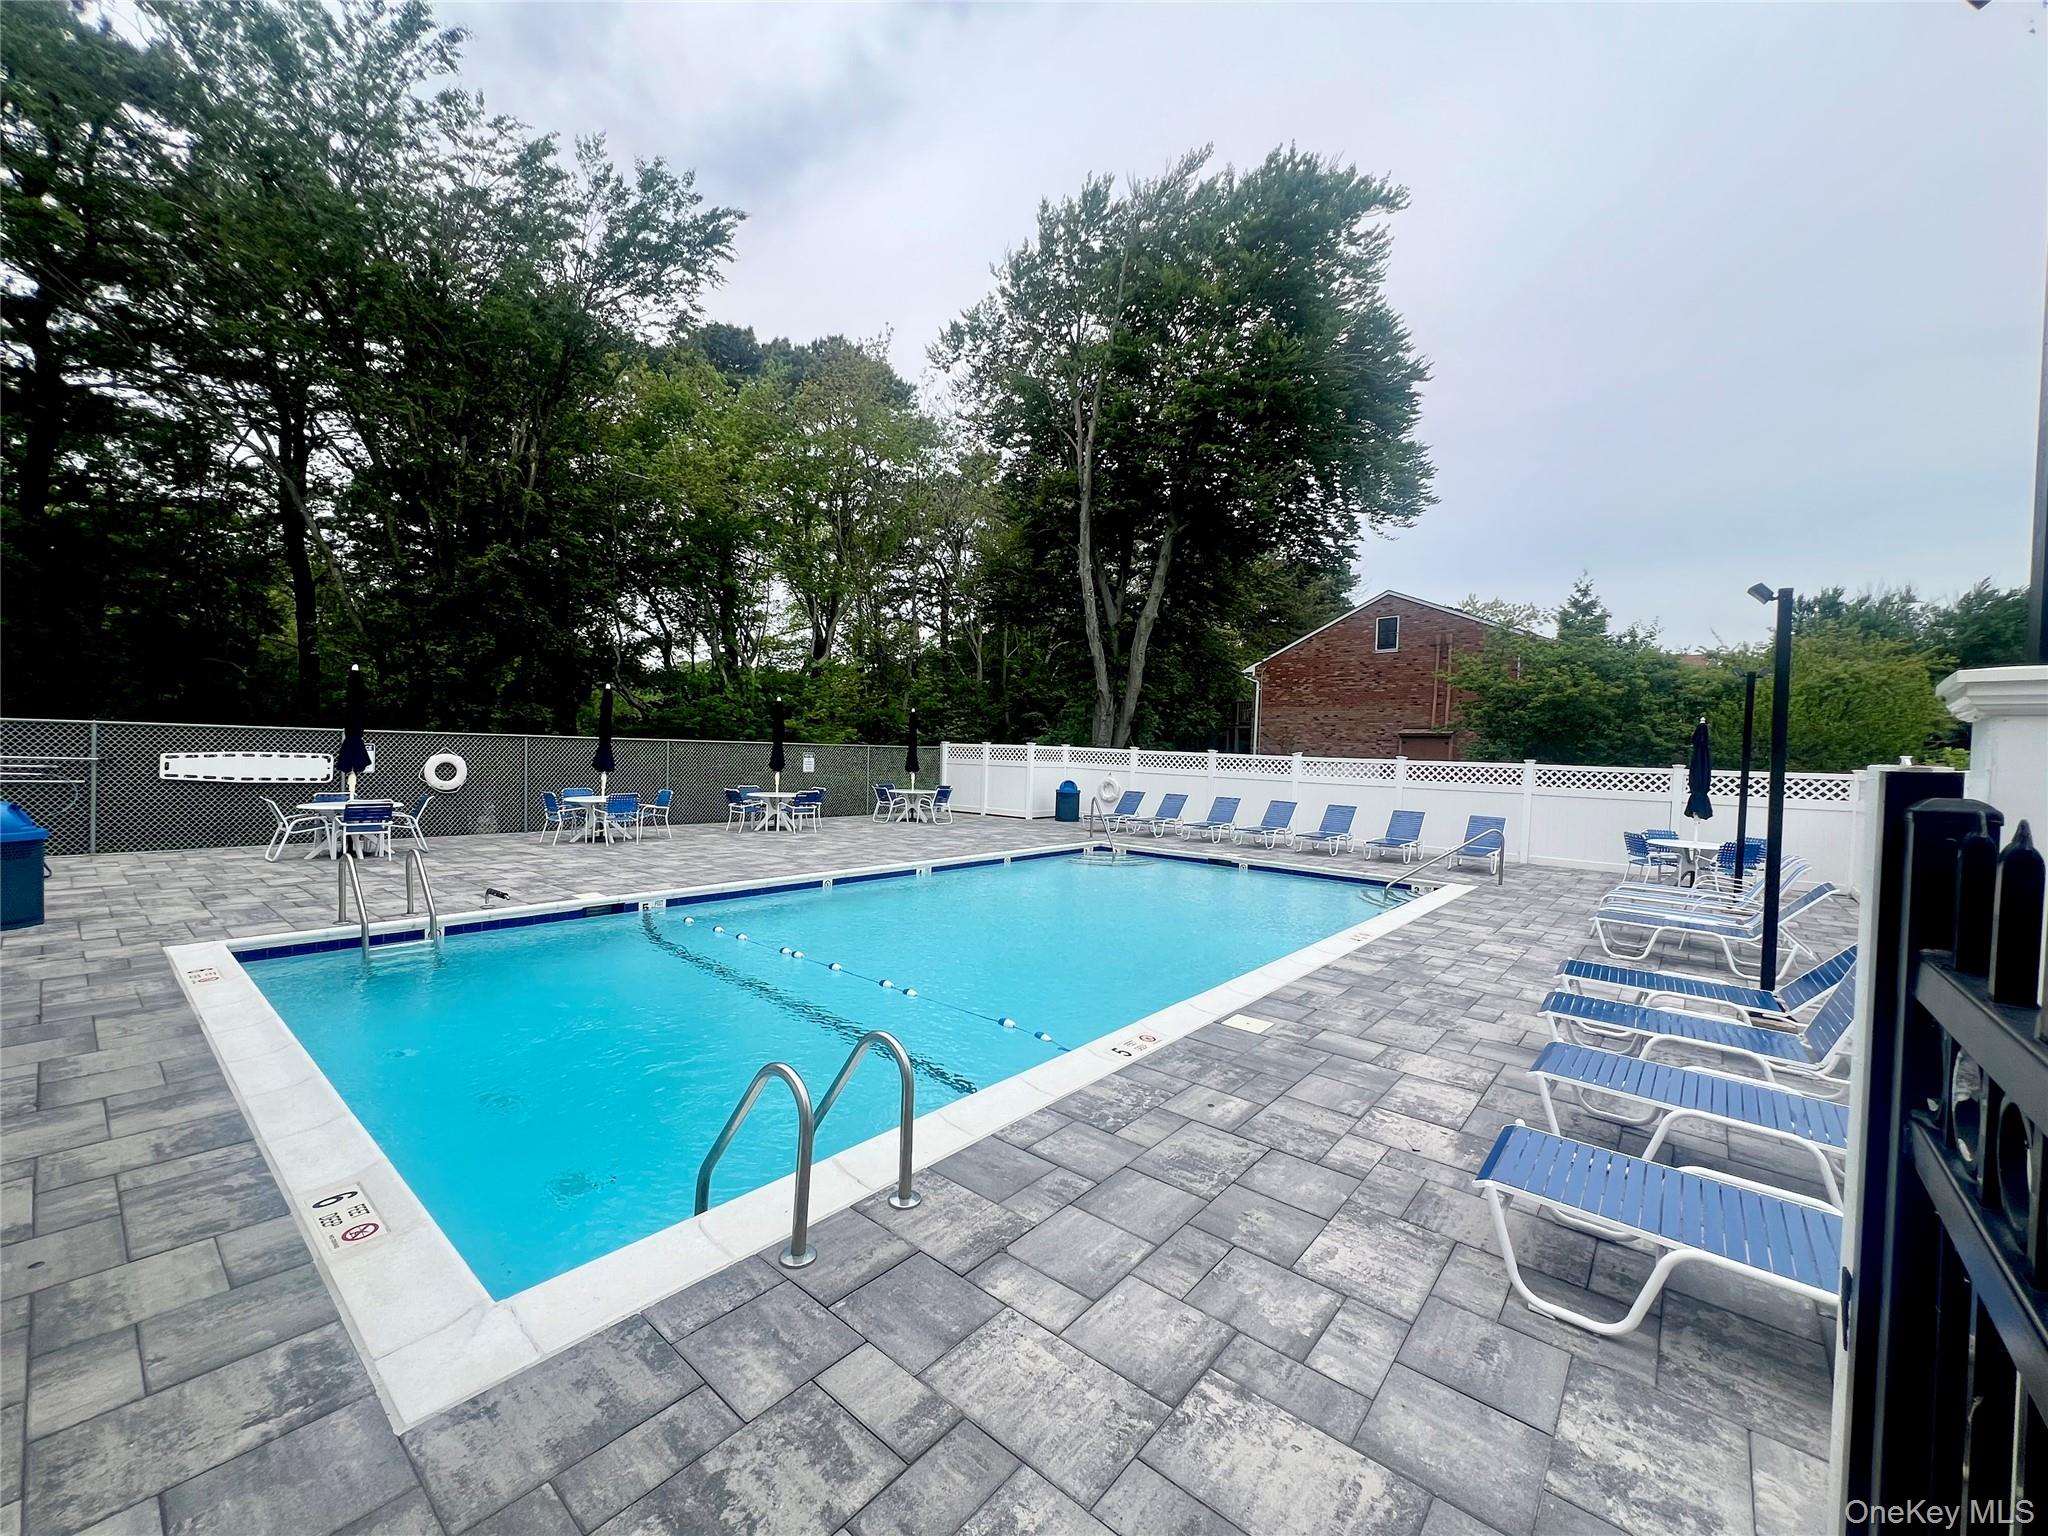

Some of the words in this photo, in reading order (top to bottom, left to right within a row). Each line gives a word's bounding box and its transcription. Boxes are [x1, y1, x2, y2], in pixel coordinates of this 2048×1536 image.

[1111, 1047, 1132, 1057] 5
[312, 1191, 358, 1209] 6
[347, 1203, 370, 1218] FEET
[318, 1212, 343, 1228] DEEP
